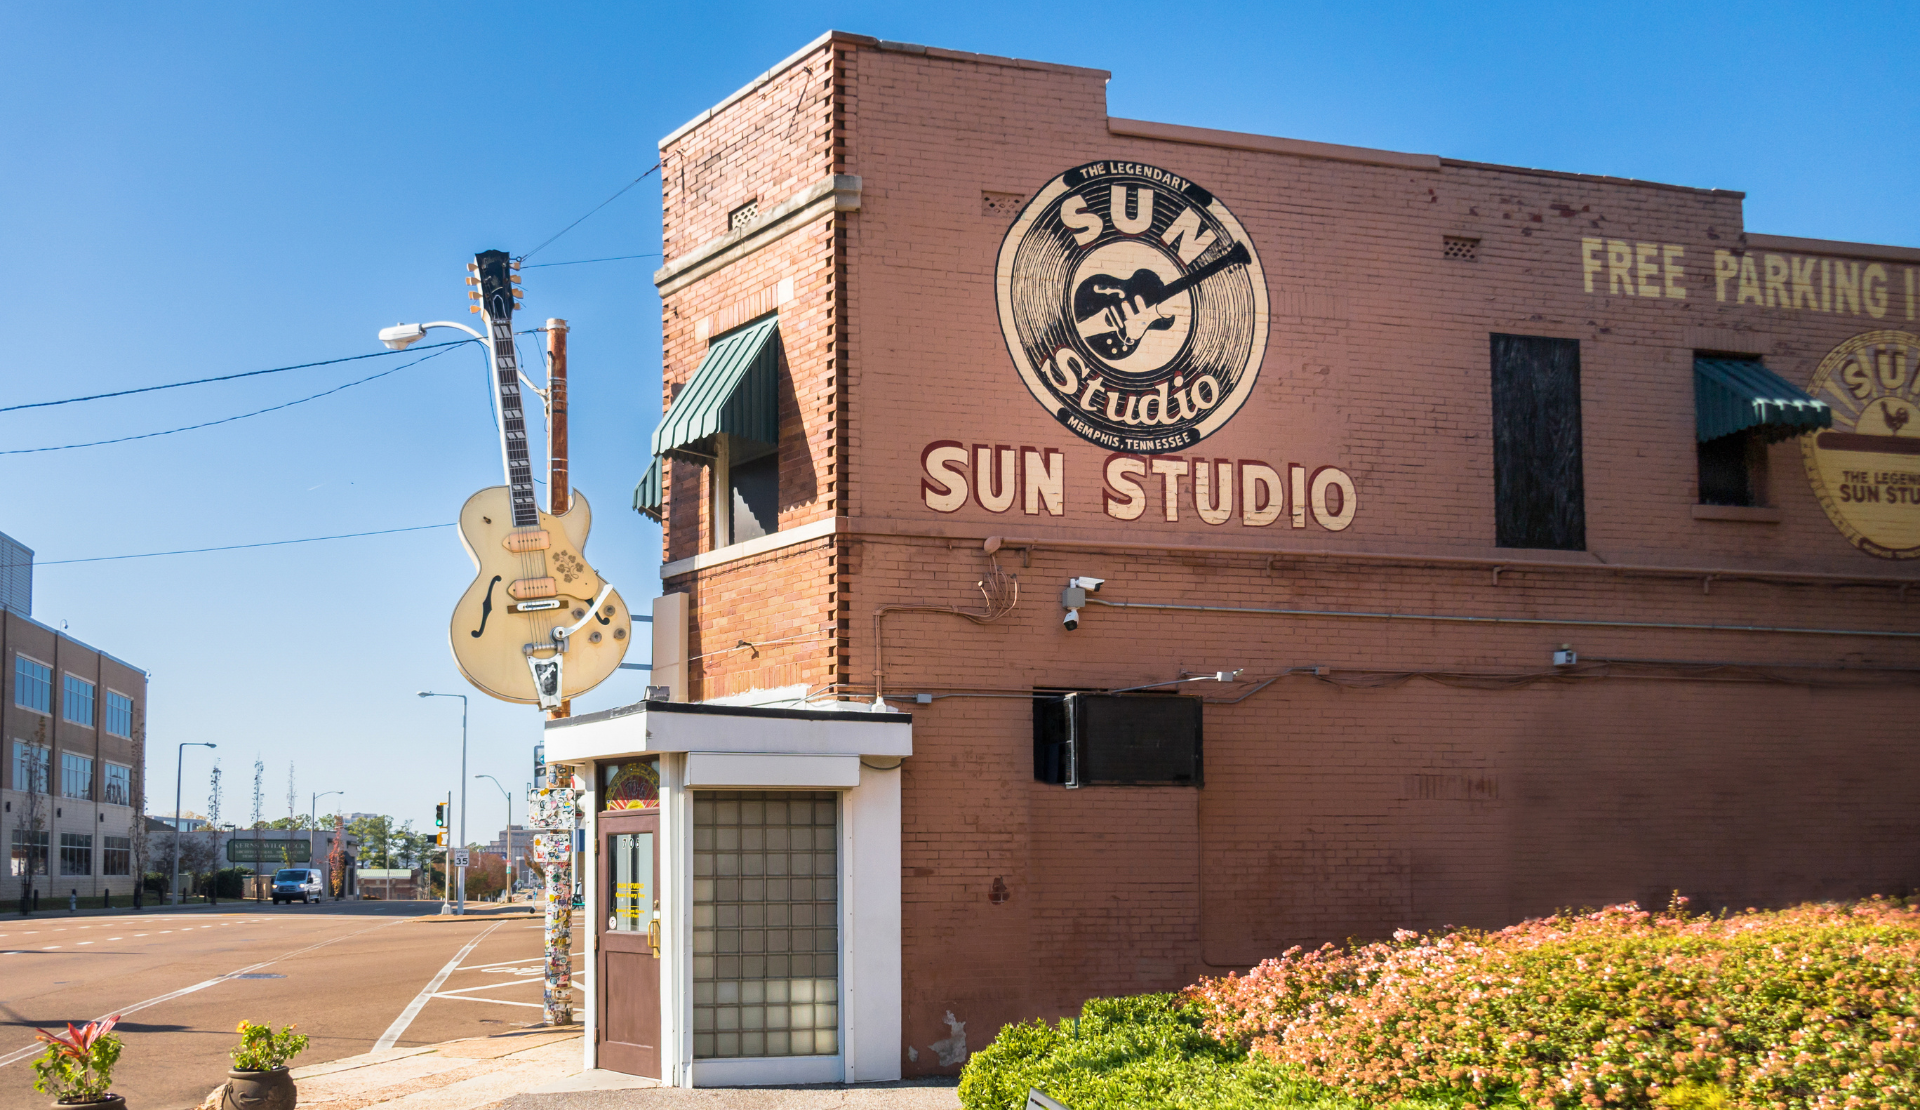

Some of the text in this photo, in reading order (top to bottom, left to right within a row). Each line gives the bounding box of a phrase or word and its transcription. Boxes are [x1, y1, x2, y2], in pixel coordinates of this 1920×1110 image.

[1080, 162, 1191, 193] THE LEGENDARY
[1060, 184, 1218, 268] SUN
[1581, 237, 1687, 300] FREE
[1713, 248, 1889, 319] PARKING
[1040, 344, 1220, 426] Studio
[1840, 349, 1920, 400] SU
[1066, 415, 1191, 451] MEMPHIS, TENNESSEE
[920, 439, 1358, 533] SUN STUDIO
[1839, 484, 1880, 504] SUN
[1842, 470, 1868, 484] THE
[456, 857, 468, 865] 35
[622, 837, 640, 850] 706
